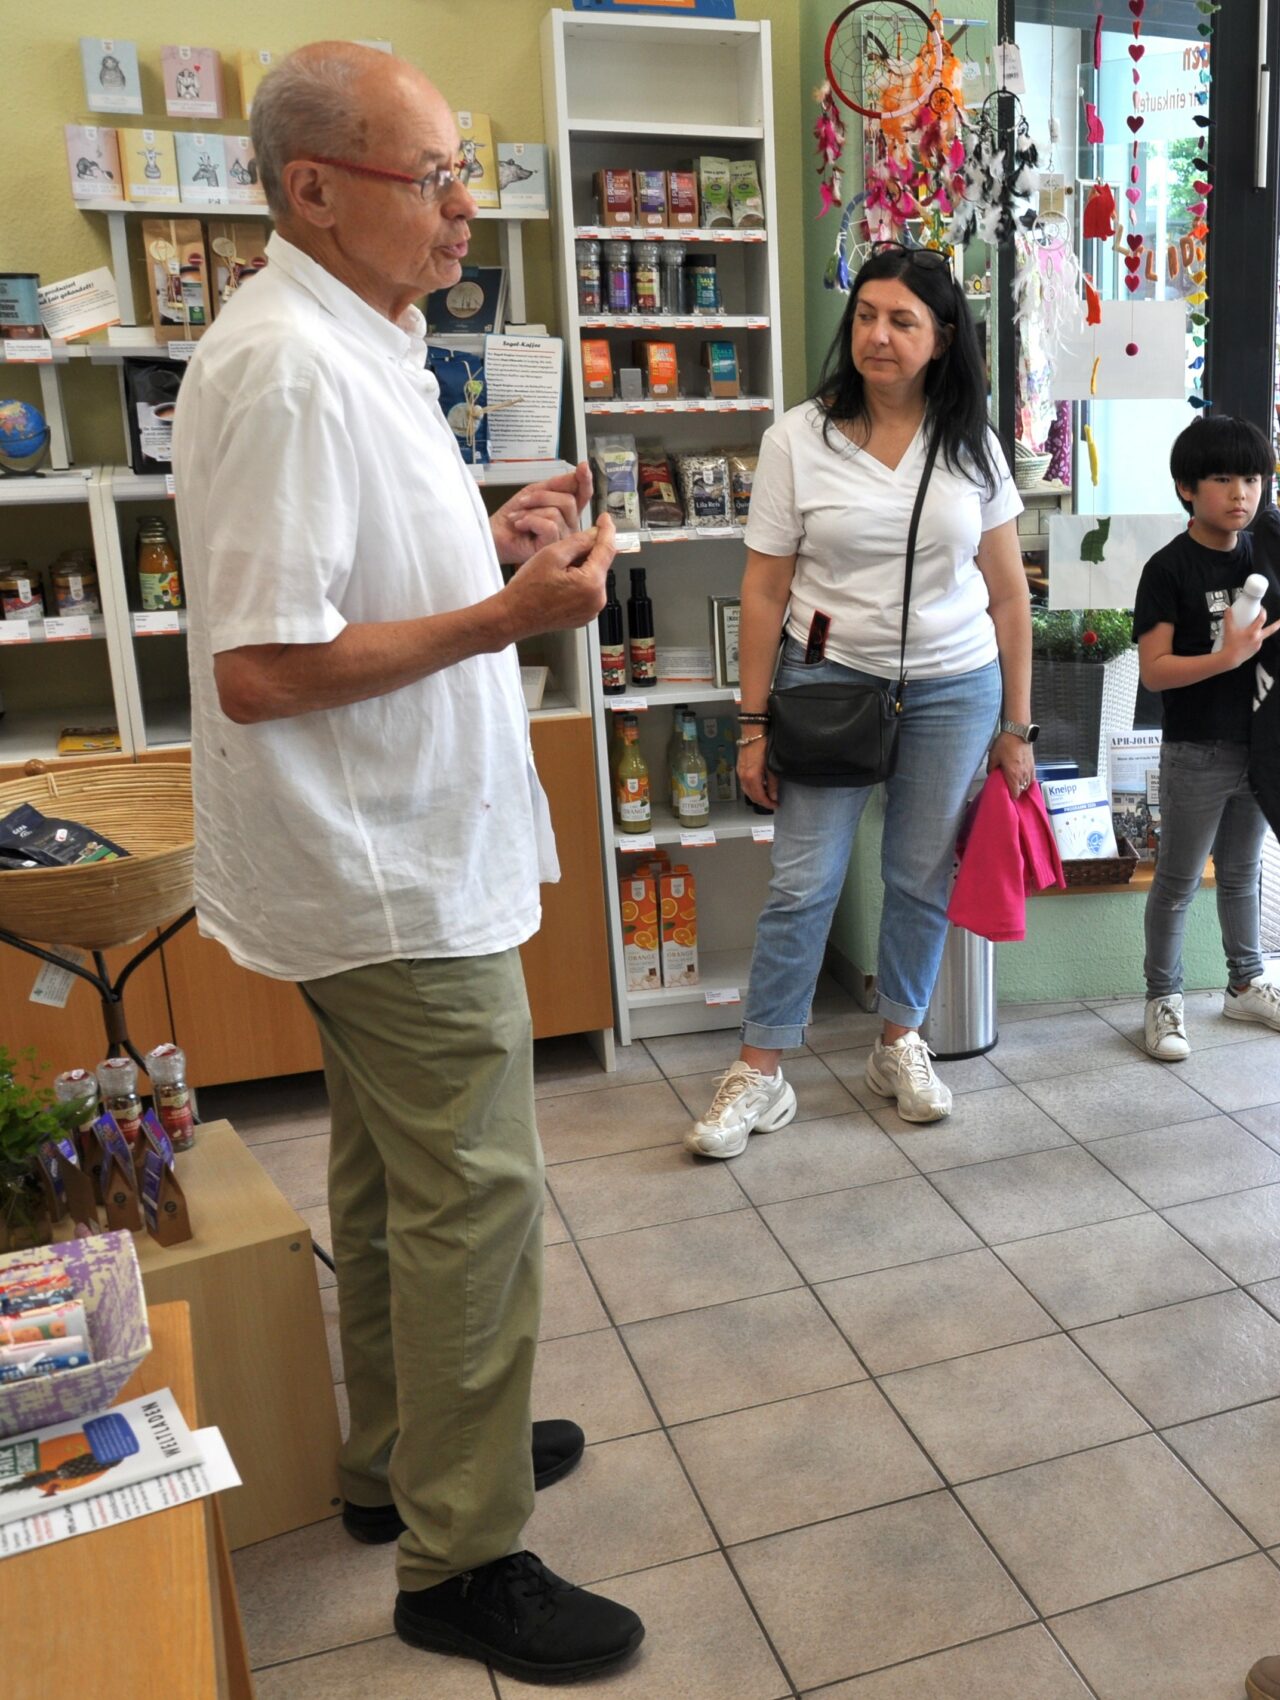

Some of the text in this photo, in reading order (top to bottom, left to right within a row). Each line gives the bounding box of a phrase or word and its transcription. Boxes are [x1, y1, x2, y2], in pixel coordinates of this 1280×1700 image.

[1111, 736, 1160, 746] APH-JOURN
[1048, 784, 1077, 796] Kneipp
[141, 1401, 181, 1458] WELTLADEN
